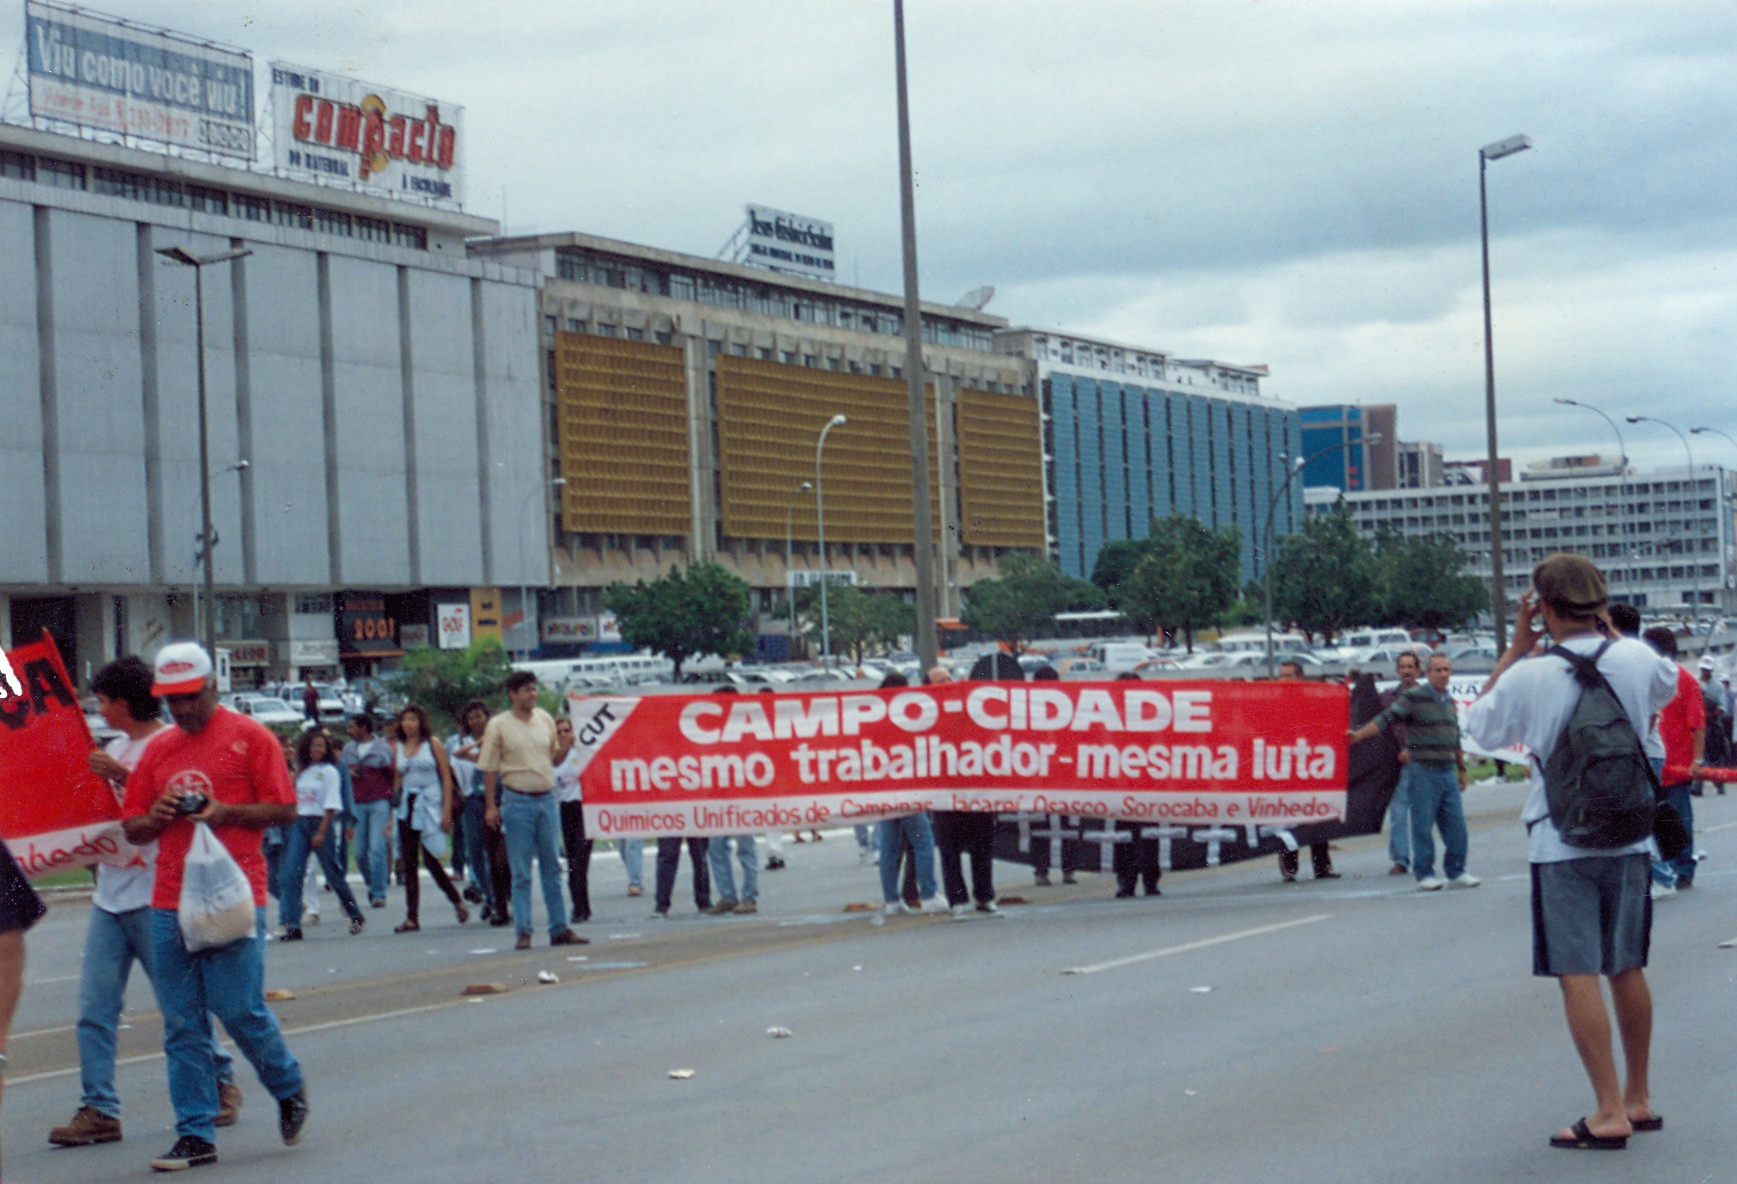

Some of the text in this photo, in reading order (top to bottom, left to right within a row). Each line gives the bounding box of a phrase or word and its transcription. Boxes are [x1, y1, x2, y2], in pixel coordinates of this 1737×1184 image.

[36, 25, 76, 80] Viu
[82, 50, 145, 98] como
[149, 63, 201, 106] você
[206, 70, 247, 118] viu!
[579, 702, 617, 746] CUT
[679, 686, 1212, 744] CAMPO-CIDADE
[610, 752, 775, 792] mesmo
[1252, 738, 1336, 781] luta
[693, 803, 801, 830] Unificados
[805, 801, 830, 823] de
[1121, 797, 1218, 819] Sorocaba
[1226, 805, 1241, 818] e
[1248, 796, 1331, 818] Vinhedo
